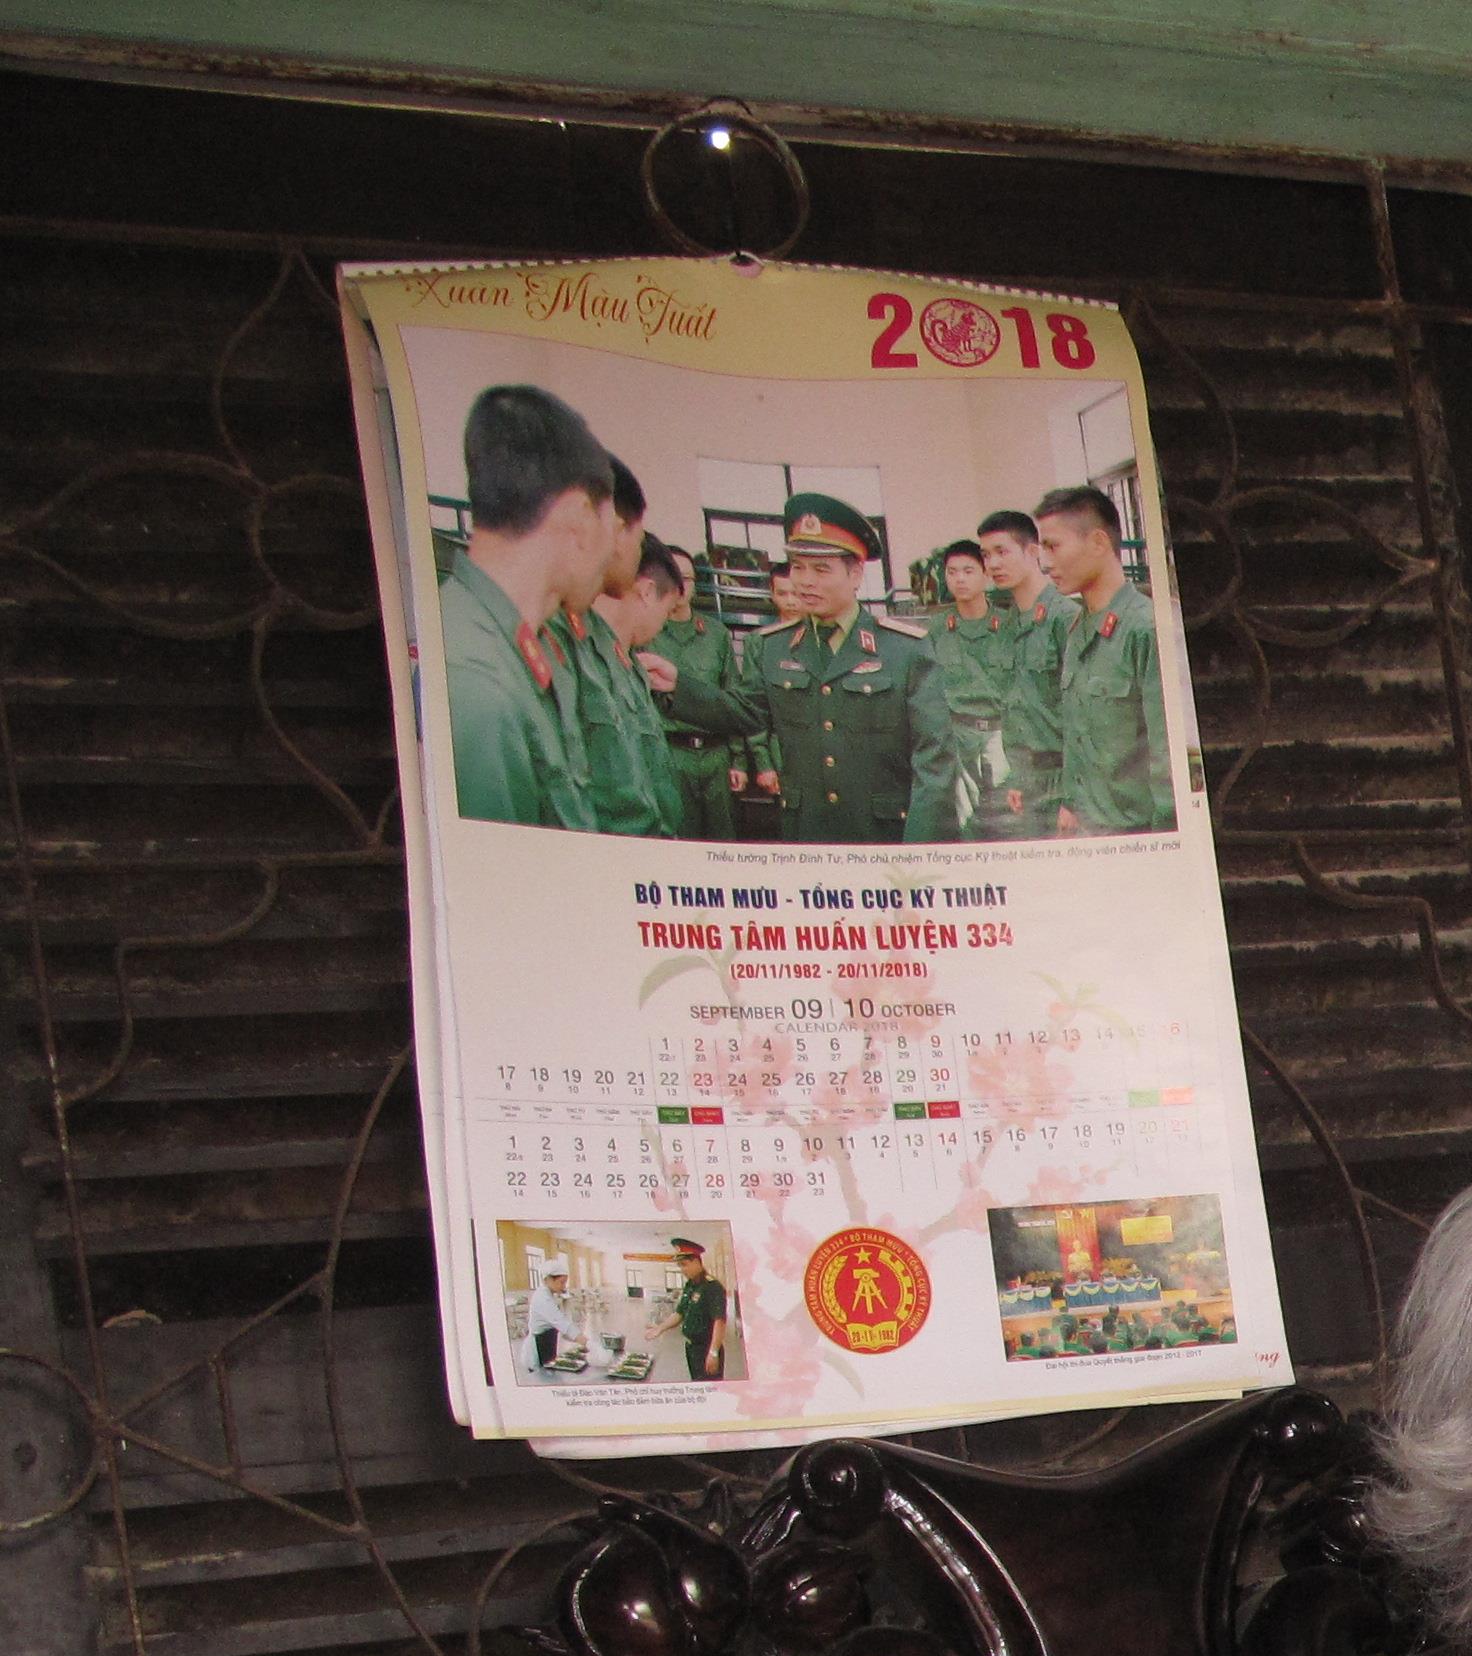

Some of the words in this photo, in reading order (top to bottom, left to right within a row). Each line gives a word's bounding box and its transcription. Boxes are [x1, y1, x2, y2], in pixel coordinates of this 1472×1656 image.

[517, 272, 629, 328] Mậu
[637, 275, 717, 343] Tuất
[635, 883, 662, 910] BỘ
[668, 886, 725, 908] THAM
[733, 887, 778, 909] MƯU
[800, 884, 853, 909] TỔNG
[862, 888, 904, 913] CỤC
[911, 885, 937, 909] KỸ
[943, 883, 1008, 911] THUẬT
[638, 921, 722, 950] TRUNG
[730, 920, 787, 951] TÂM
[795, 916, 867, 951] HUẤN
[878, 919, 959, 955] LUYỆN
[967, 922, 1014, 948] 334
[730, 963, 822, 980] (20/11/1982
[837, 962, 928, 979] 20/11/2018)
[690, 1004, 785, 1020] SEPTEMBER
[791, 998, 824, 1020] 09
[843, 998, 875, 1019] 10
[881, 1002, 956, 1018] OCTOBER
[775, 1022, 858, 1034] CALENDAR
[661, 1037, 669, 1051] 1
[694, 1038, 705, 1052] 2
[729, 1038, 739, 1052] 3
[762, 1038, 772, 1051] 4
[796, 1038, 806, 1052] 5
[830, 1038, 841, 1051] 6
[864, 1037, 872, 1051] 7
[897, 1035, 907, 1049] 8
[930, 1035, 941, 1048] 9
[961, 1033, 981, 1047] 10
[995, 1031, 1012, 1044] 11
[1028, 1030, 1048, 1044] 12
[1062, 1028, 1081, 1043] 13
[497, 1066, 516, 1080] 17
[530, 1067, 550, 1082] 18
[562, 1069, 582, 1083] 19
[594, 1070, 614, 1084] 20
[627, 1072, 646, 1086] 21
[660, 1072, 679, 1086] 22
[693, 1073, 713, 1087] 23
[728, 1073, 747, 1087] 24
[761, 1073, 782, 1087] 25
[795, 1072, 816, 1086] 26
[828, 1072, 848, 1085] 27
[863, 1071, 883, 1085] 28
[896, 1069, 916, 1083] 29
[929, 1068, 950, 1082] 30
[508, 1135, 517, 1149] 1
[541, 1136, 552, 1150] 2
[574, 1137, 585, 1152] 3
[607, 1138, 617, 1152] 4
[639, 1139, 650, 1152] 5
[672, 1139, 683, 1153] 6
[705, 1139, 715, 1153] 7
[741, 1139, 751, 1153] 8
[774, 1138, 785, 1152] 9
[803, 1137, 824, 1151] 10
[837, 1136, 855, 1150] 11
[871, 1134, 891, 1149] 12
[904, 1133, 924, 1147] 13
[937, 1132, 957, 1146] 14
[973, 1129, 993, 1144] 15
[1006, 1128, 1026, 1142] 16
[1040, 1126, 1059, 1140] 17
[1073, 1124, 1093, 1138] 18
[1105, 1122, 1125, 1136] 19
[1138, 1121, 1158, 1135] 20
[506, 1171, 527, 1187] 22
[540, 1172, 561, 1187] 23
[573, 1173, 593, 1188] 24
[606, 1173, 626, 1188] 25
[639, 1174, 659, 1188] 26
[672, 1174, 691, 1188] 27
[705, 1174, 725, 1188] 28
[739, 1173, 760, 1188] 29
[773, 1173, 794, 1187] 30
[807, 1172, 826, 1185] 31
